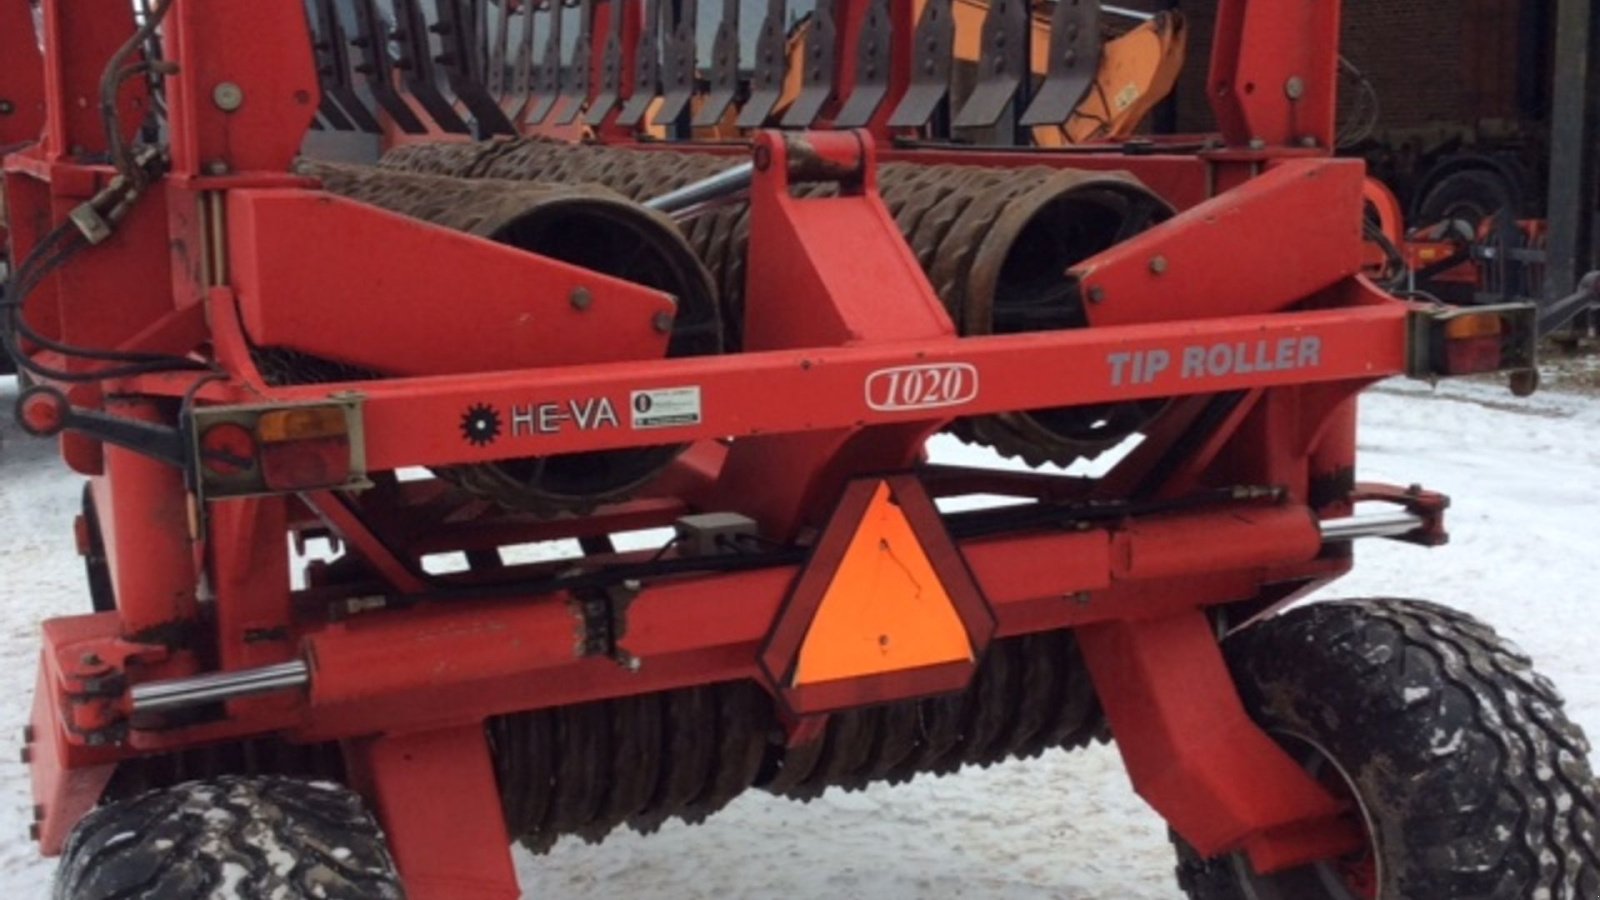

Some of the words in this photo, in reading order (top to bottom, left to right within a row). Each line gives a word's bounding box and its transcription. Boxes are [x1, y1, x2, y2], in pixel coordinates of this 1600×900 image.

[1107, 351, 1169, 386] TIP
[1181, 336, 1321, 379] ROLLER
[884, 367, 962, 406] 1020
[511, 397, 619, 436] HE-VA
